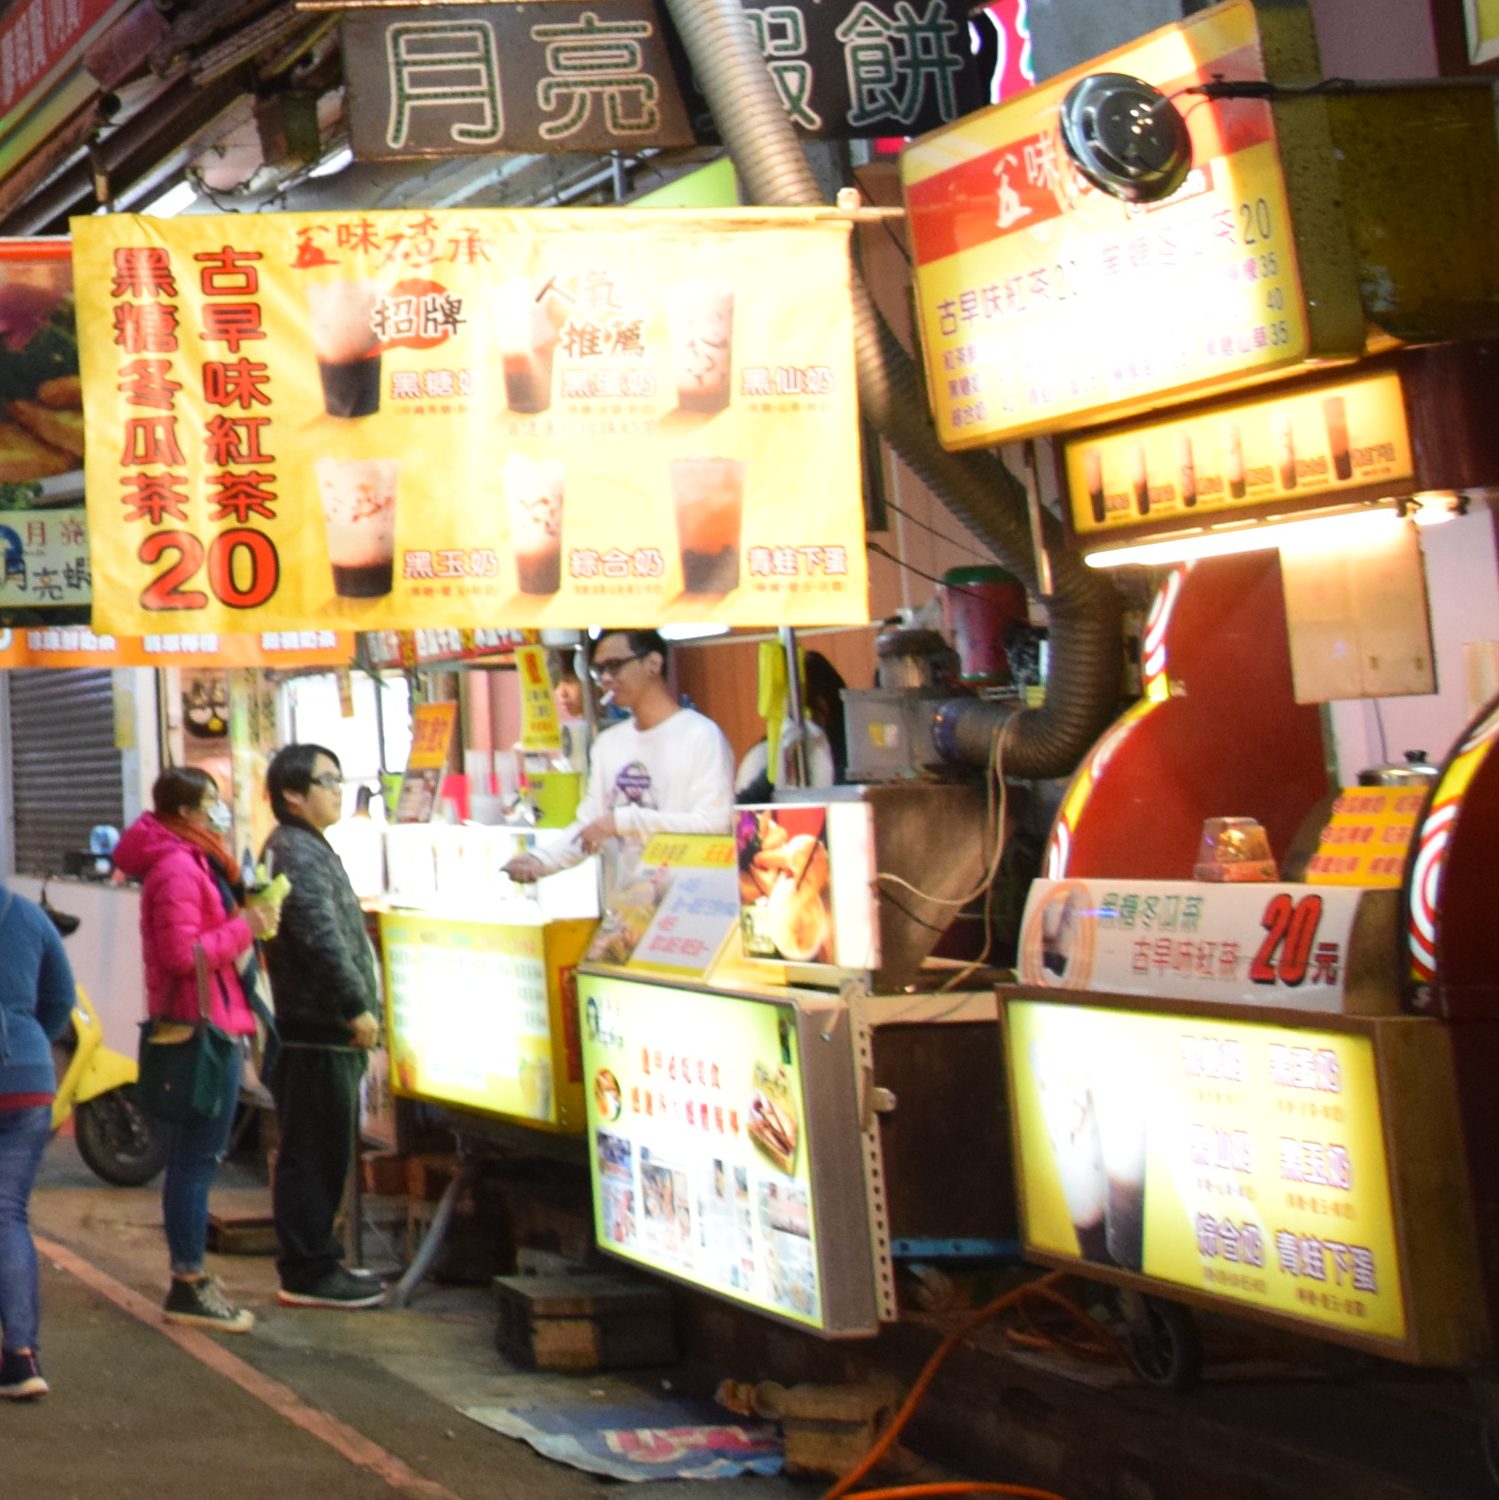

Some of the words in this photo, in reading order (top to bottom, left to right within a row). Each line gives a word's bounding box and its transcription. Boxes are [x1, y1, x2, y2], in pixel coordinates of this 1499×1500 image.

[386, 12, 660, 148] 月亮
[372, 293, 467, 338] 招牌
[562, 318, 647, 361] 推薦
[111, 246, 189, 525] 黑糖冬瓜茶
[194, 245, 277, 525] 古早味紅茶
[390, 368, 486, 399] 黑糖奶
[560, 368, 659, 399] 黑蛋奶
[740, 365, 836, 396] 黑仙奶
[137, 527, 280, 612] 20
[403, 548, 500, 580] 黑玉奶
[568, 547, 666, 579] 綜合奶
[747, 544, 849, 577] 青蛙下蛋
[1132, 937, 1239, 980] 古早味紅茶
[1279, 1135, 1352, 1191] 黑玉奶
[1194, 1211, 1264, 1269] 綜合奶
[1274, 1228, 1379, 1296] 青蛙下蛋
